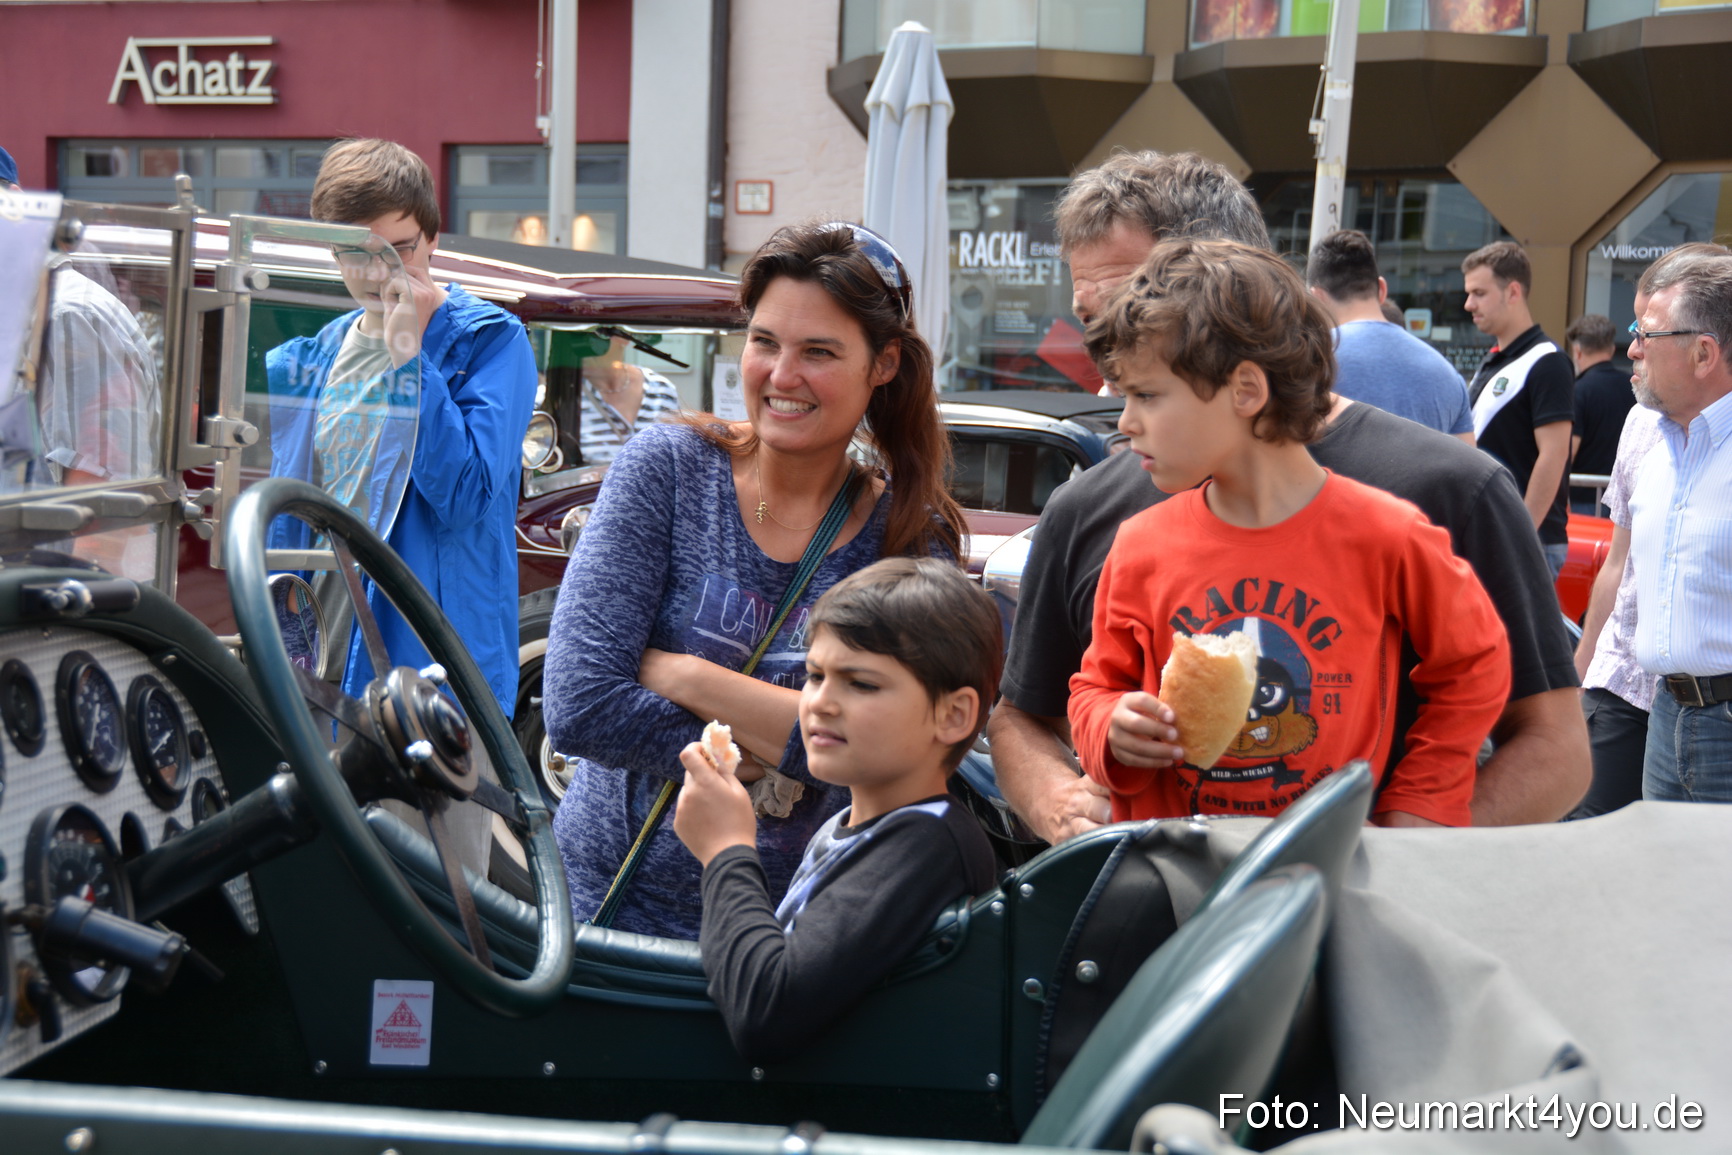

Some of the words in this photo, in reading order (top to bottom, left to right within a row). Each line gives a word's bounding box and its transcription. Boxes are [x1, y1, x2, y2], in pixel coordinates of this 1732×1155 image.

[108, 36, 274, 104] Achatz
[959, 231, 1026, 268] RACKL
[720, 587, 773, 646] CAN
[1169, 577, 1343, 651] RACING
[1316, 673, 1352, 683] POWER
[1322, 692, 1342, 715] 91
[1211, 770, 1231, 778] WILD
[1242, 766, 1274, 777] WICKED
[1203, 793, 1229, 808] AND
[1232, 800, 1267, 812] WITH
[1270, 796, 1289, 809] NO
